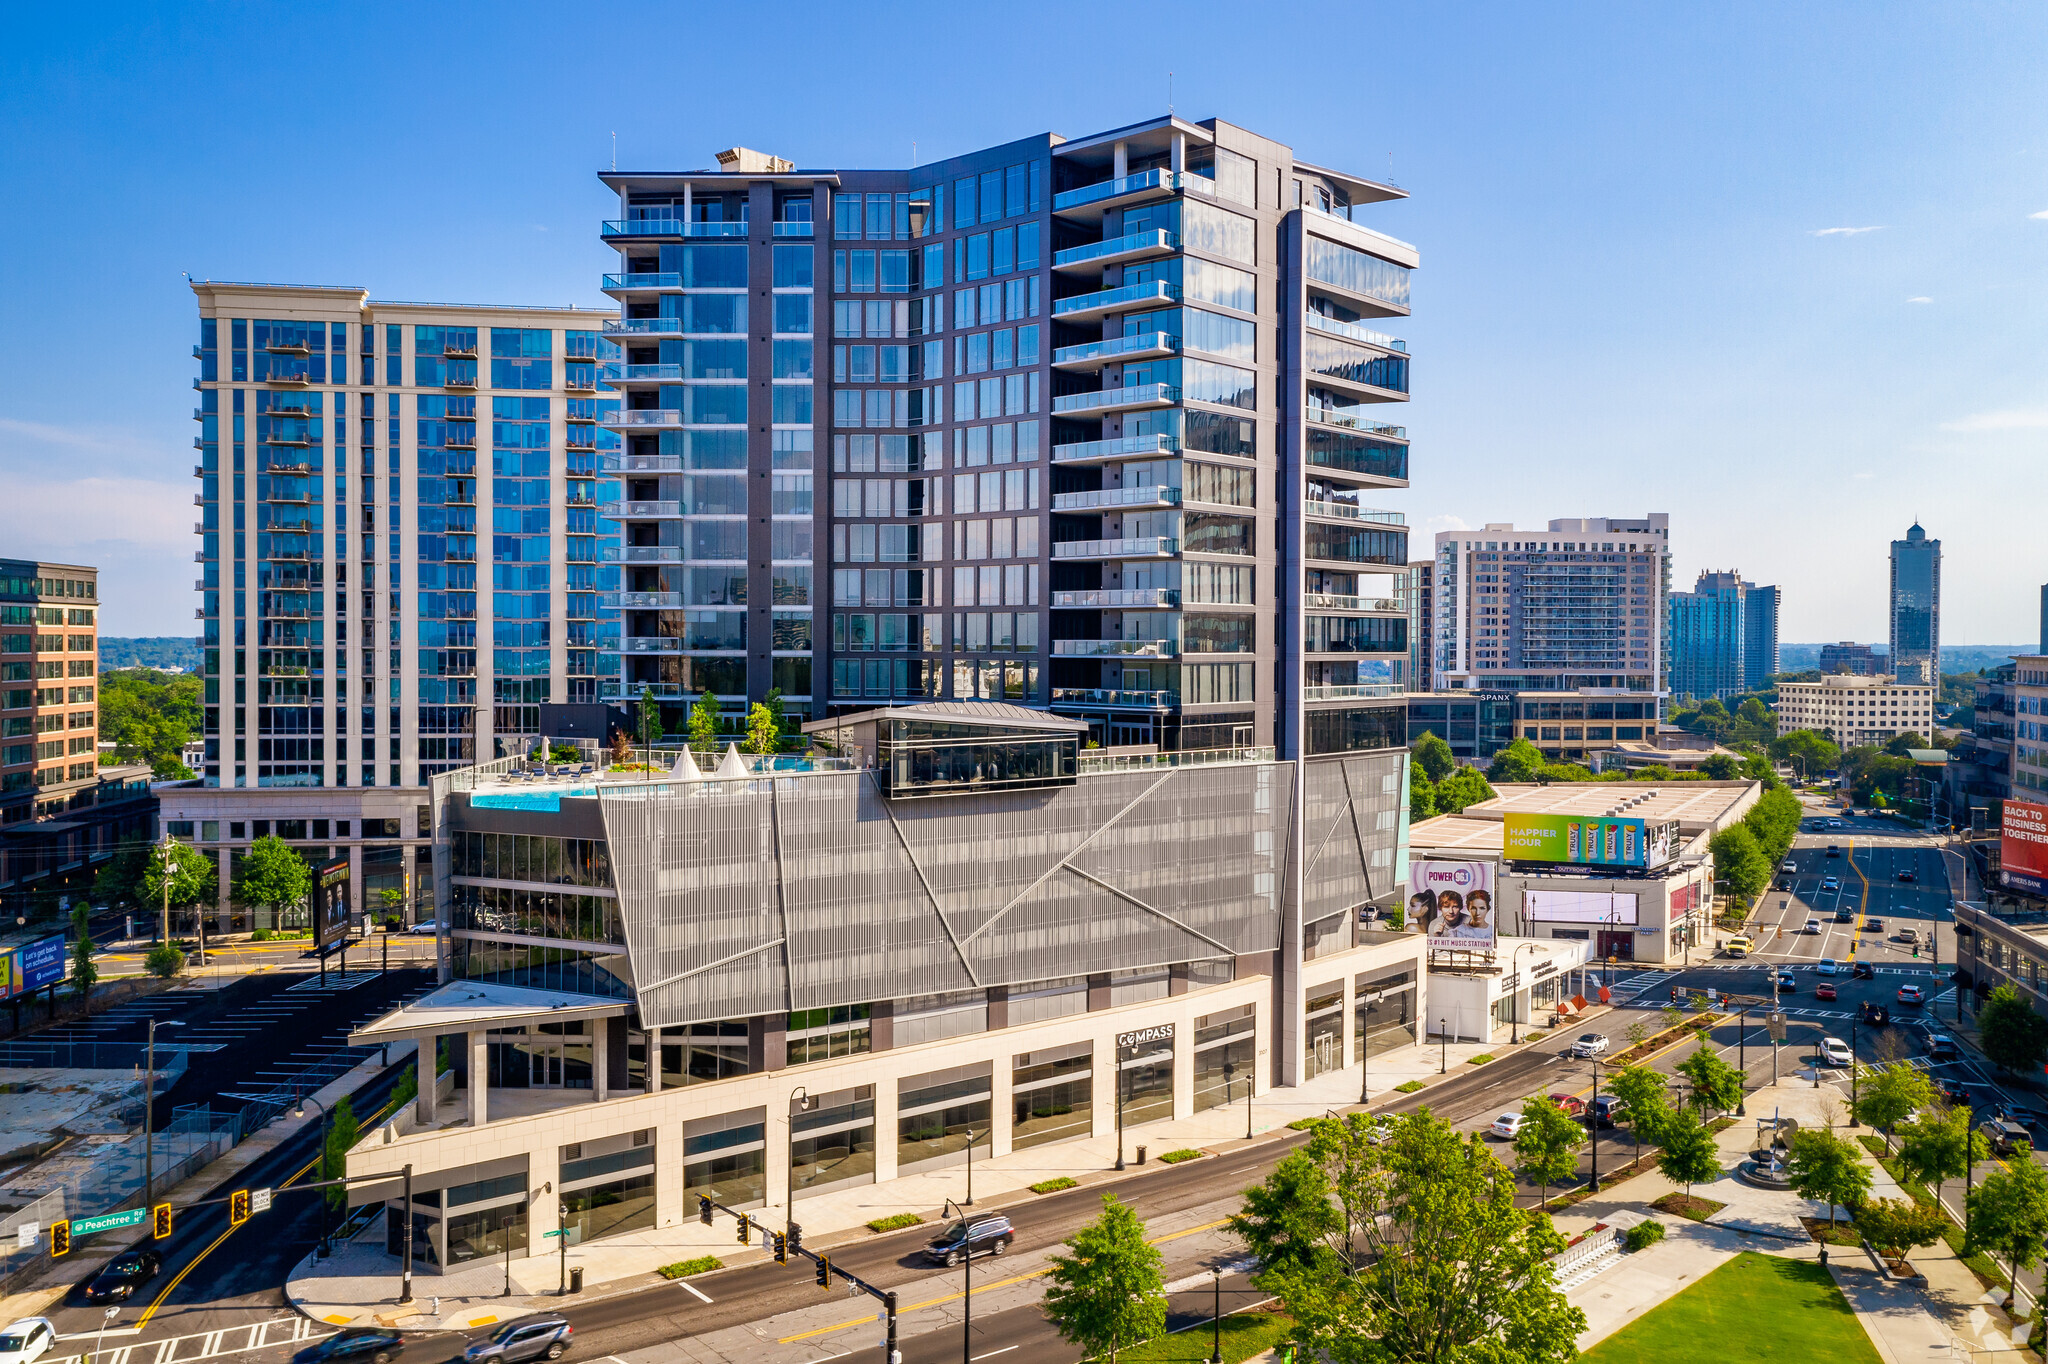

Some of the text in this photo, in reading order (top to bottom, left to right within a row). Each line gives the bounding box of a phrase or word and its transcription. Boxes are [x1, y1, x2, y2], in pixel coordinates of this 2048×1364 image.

[2004, 806, 2042, 820] BACK TO
[2004, 817, 2047, 832] BUSINESS
[1510, 828, 1556, 837] HAPPIER
[2003, 828, 2048, 844] TOGETHER
[1510, 838, 1541, 847] HOUR
[1428, 871, 1453, 881] POWER
[2028, 880, 2041, 888] BANK
[25, 952, 36, 960] Let's
[37, 949, 45, 959] get
[46, 944, 57, 953] back
[1119, 1025, 1173, 1045] COMPASS
[254, 1198, 269, 1206] BLOCK
[85, 1216, 130, 1230] Peachtree
